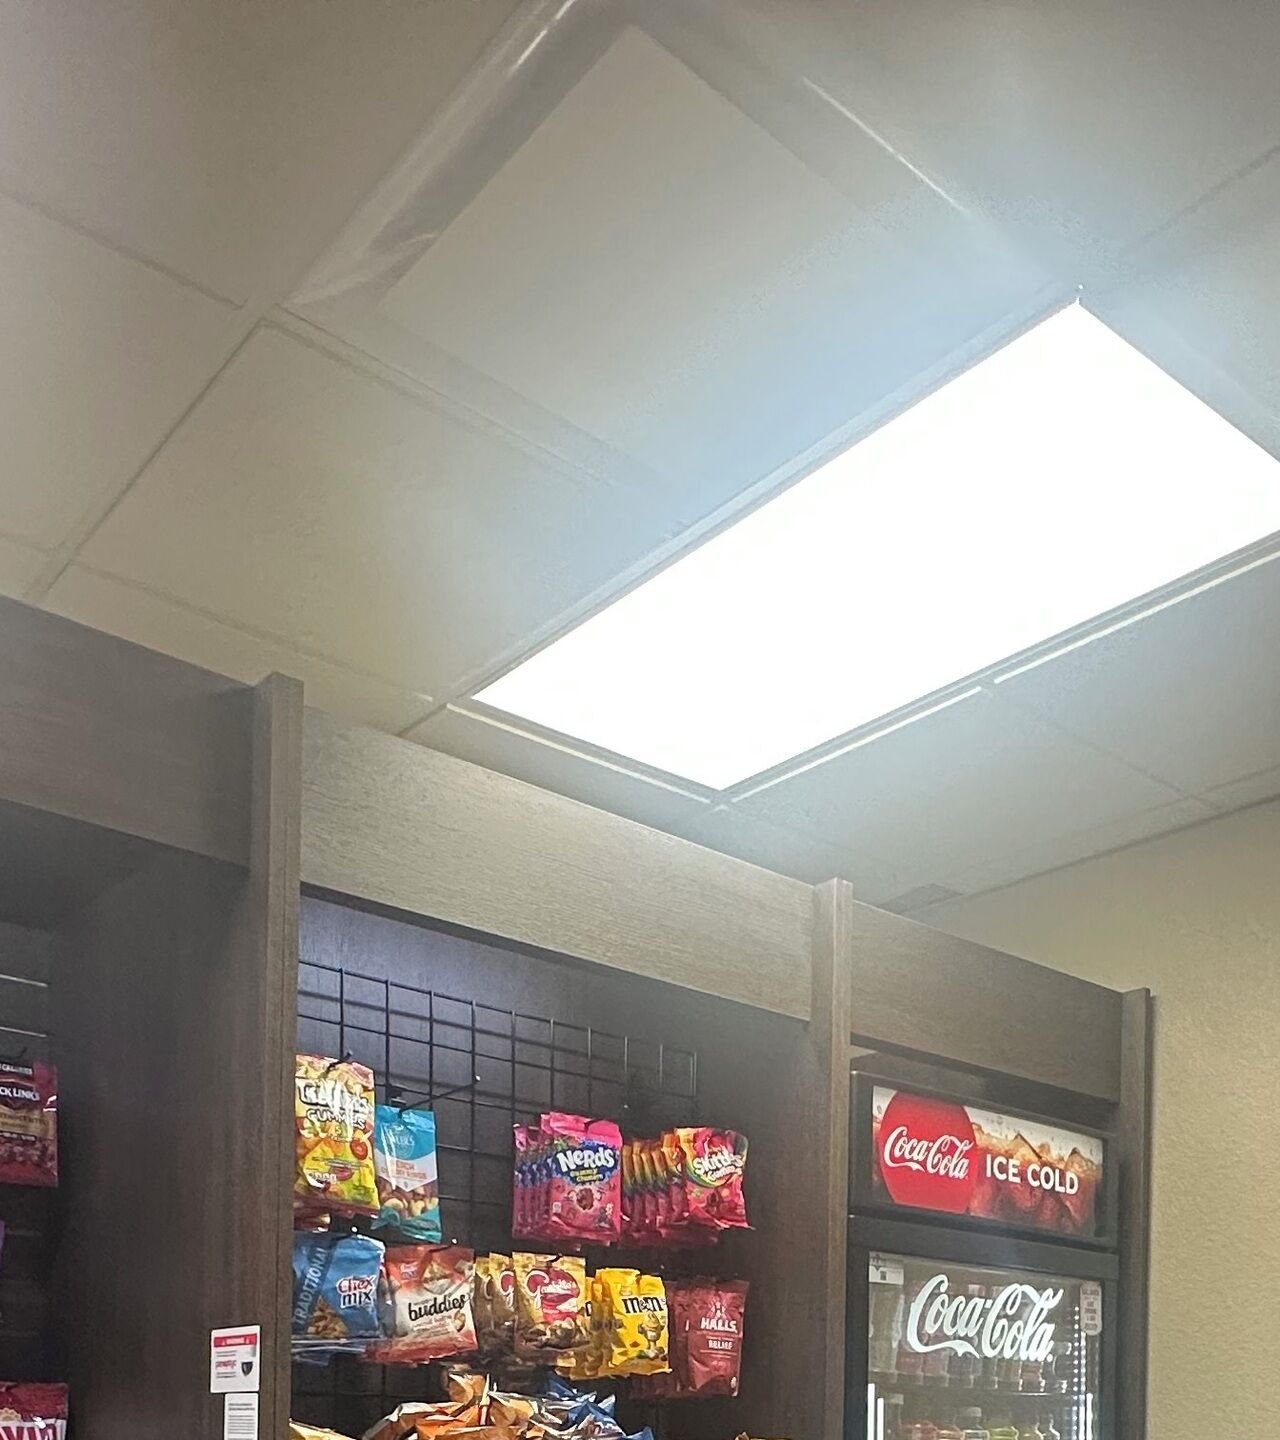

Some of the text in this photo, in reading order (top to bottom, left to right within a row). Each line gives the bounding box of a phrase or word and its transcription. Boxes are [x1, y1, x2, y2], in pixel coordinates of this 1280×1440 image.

[883, 1126, 1079, 1195] Coca-Cola ICE COLD
[337, 1275, 376, 1293] Chex
[340, 1291, 373, 1308] mix
[407, 1294, 467, 1322] buddies
[700, 1317, 738, 1333] HALLS
[906, 1274, 1064, 1363] Coca-Cola
